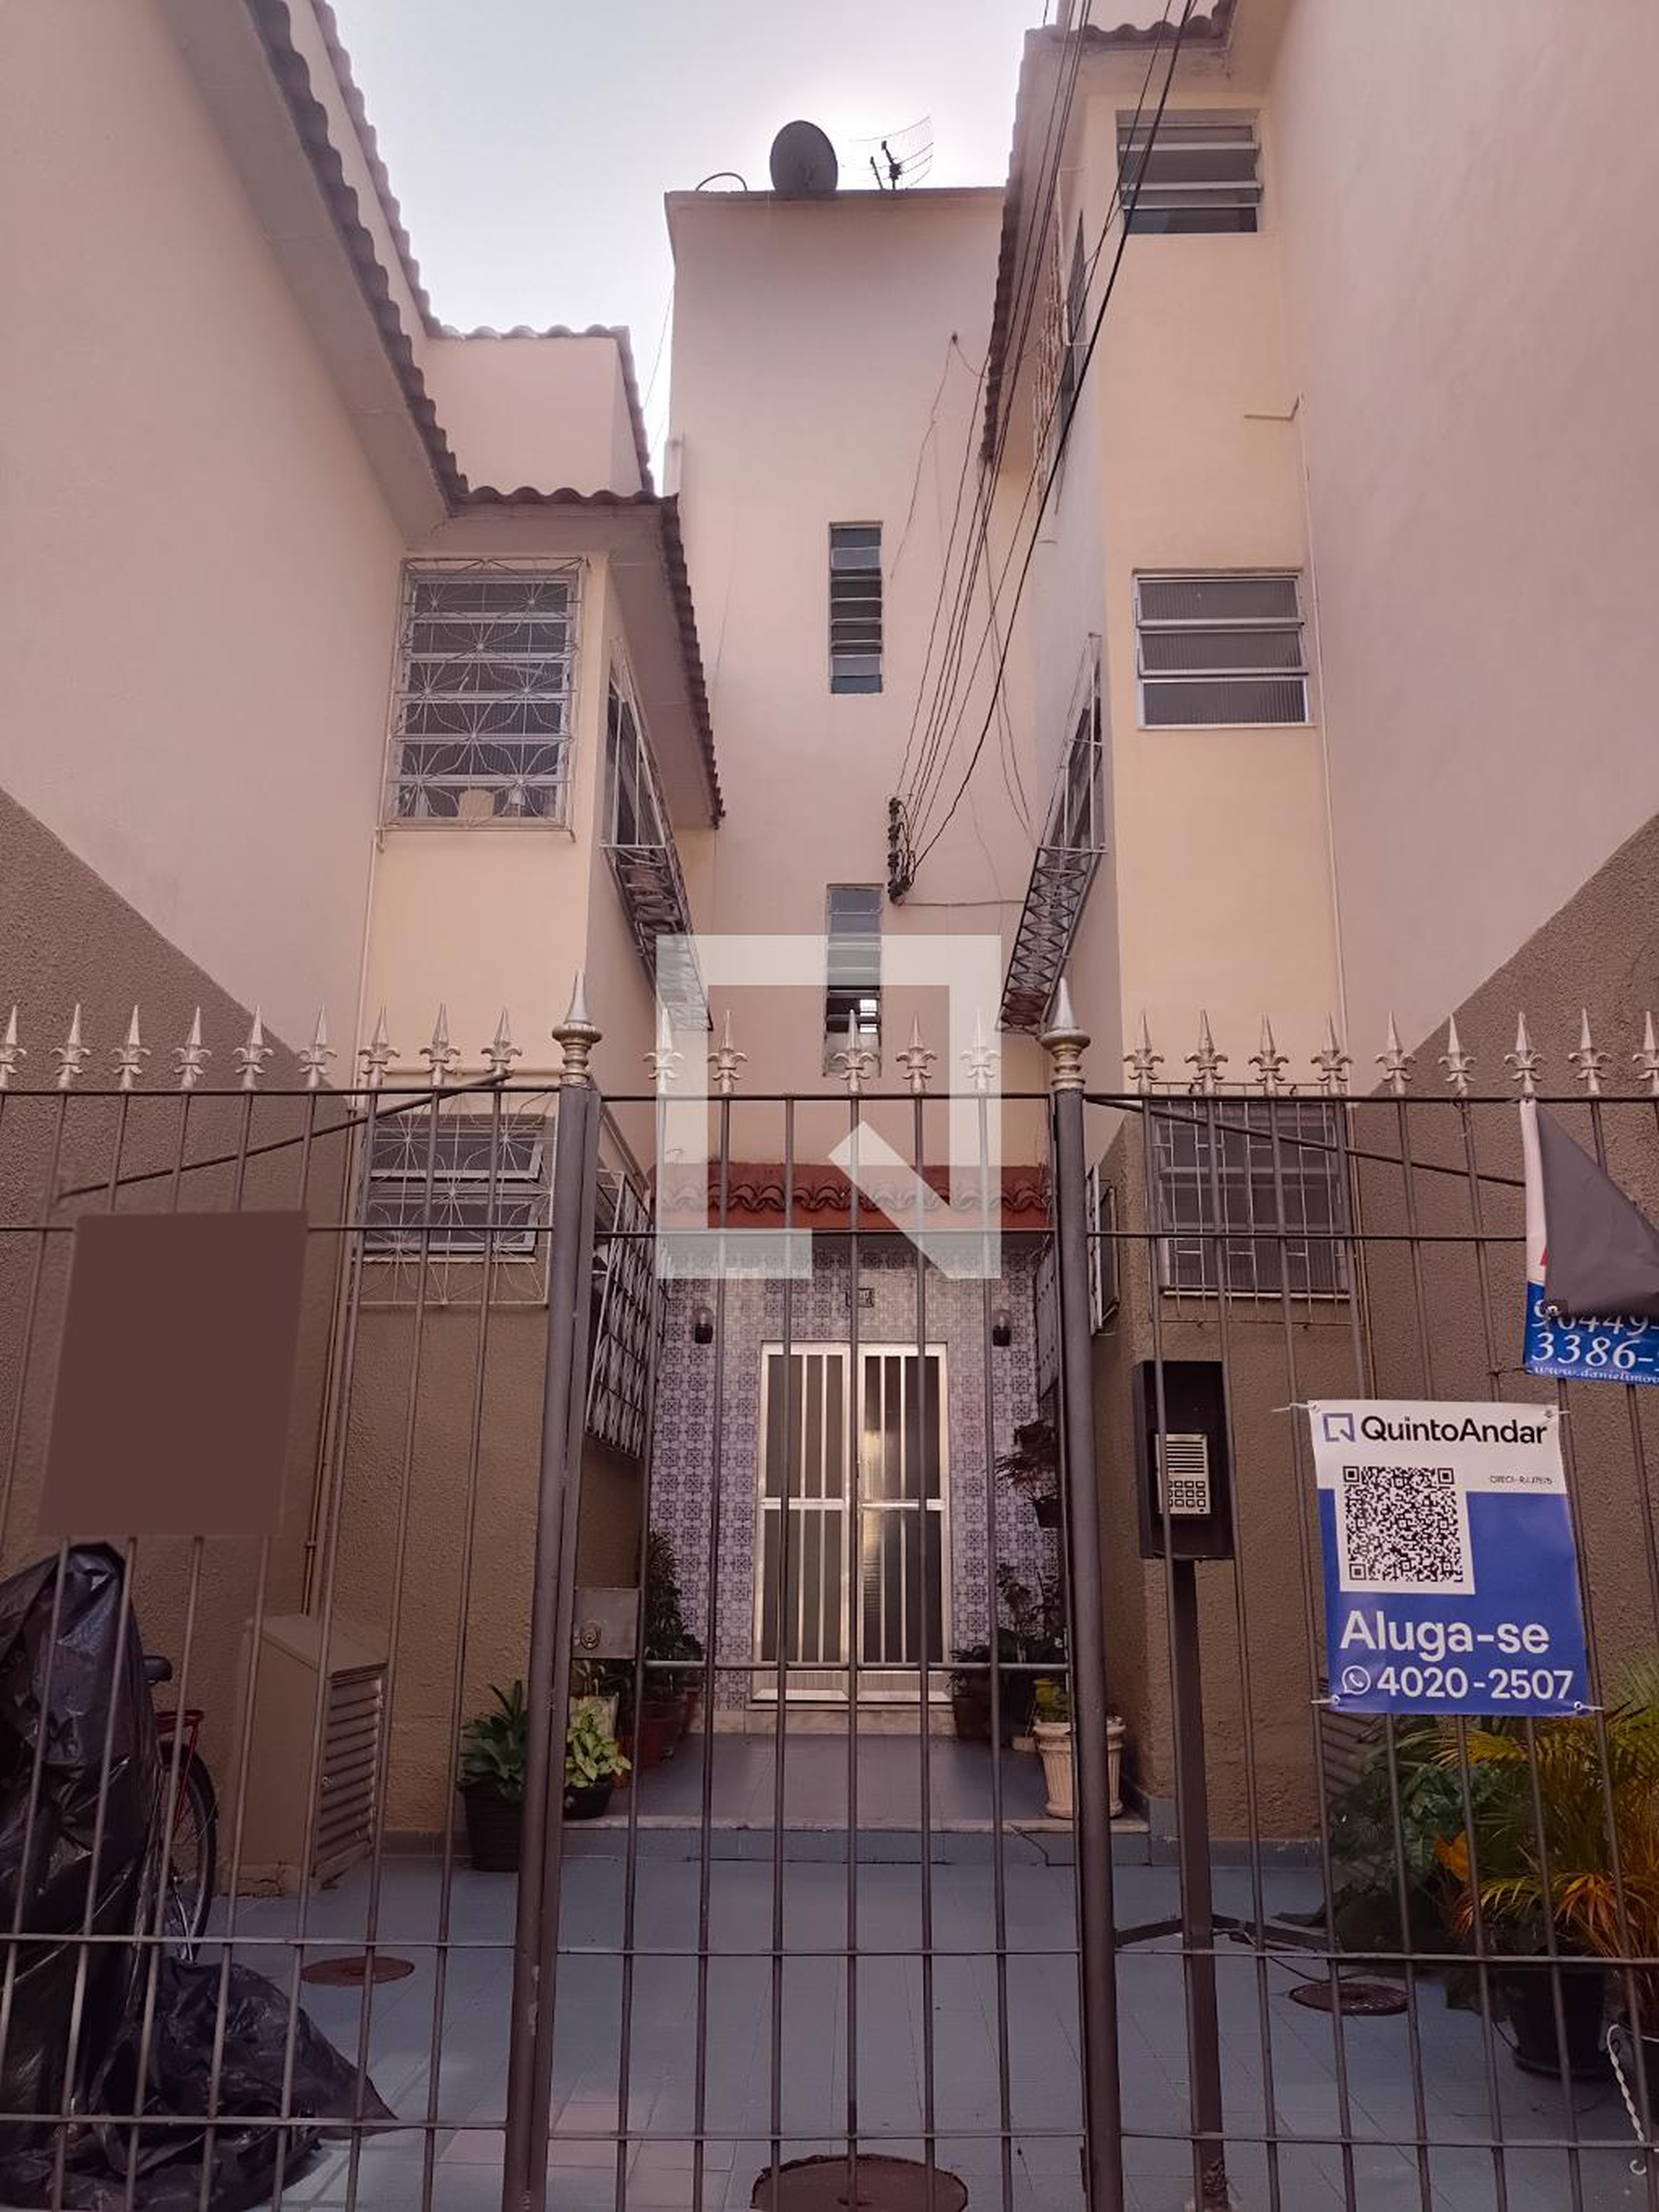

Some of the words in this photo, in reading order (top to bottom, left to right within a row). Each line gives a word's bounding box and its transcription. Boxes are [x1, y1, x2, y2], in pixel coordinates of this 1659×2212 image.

[1361, 1416, 1547, 1444] QuintoAndar
[1340, 1610, 1549, 1662] Aluga-se
[1377, 1667, 1574, 1700] 4020-2507
